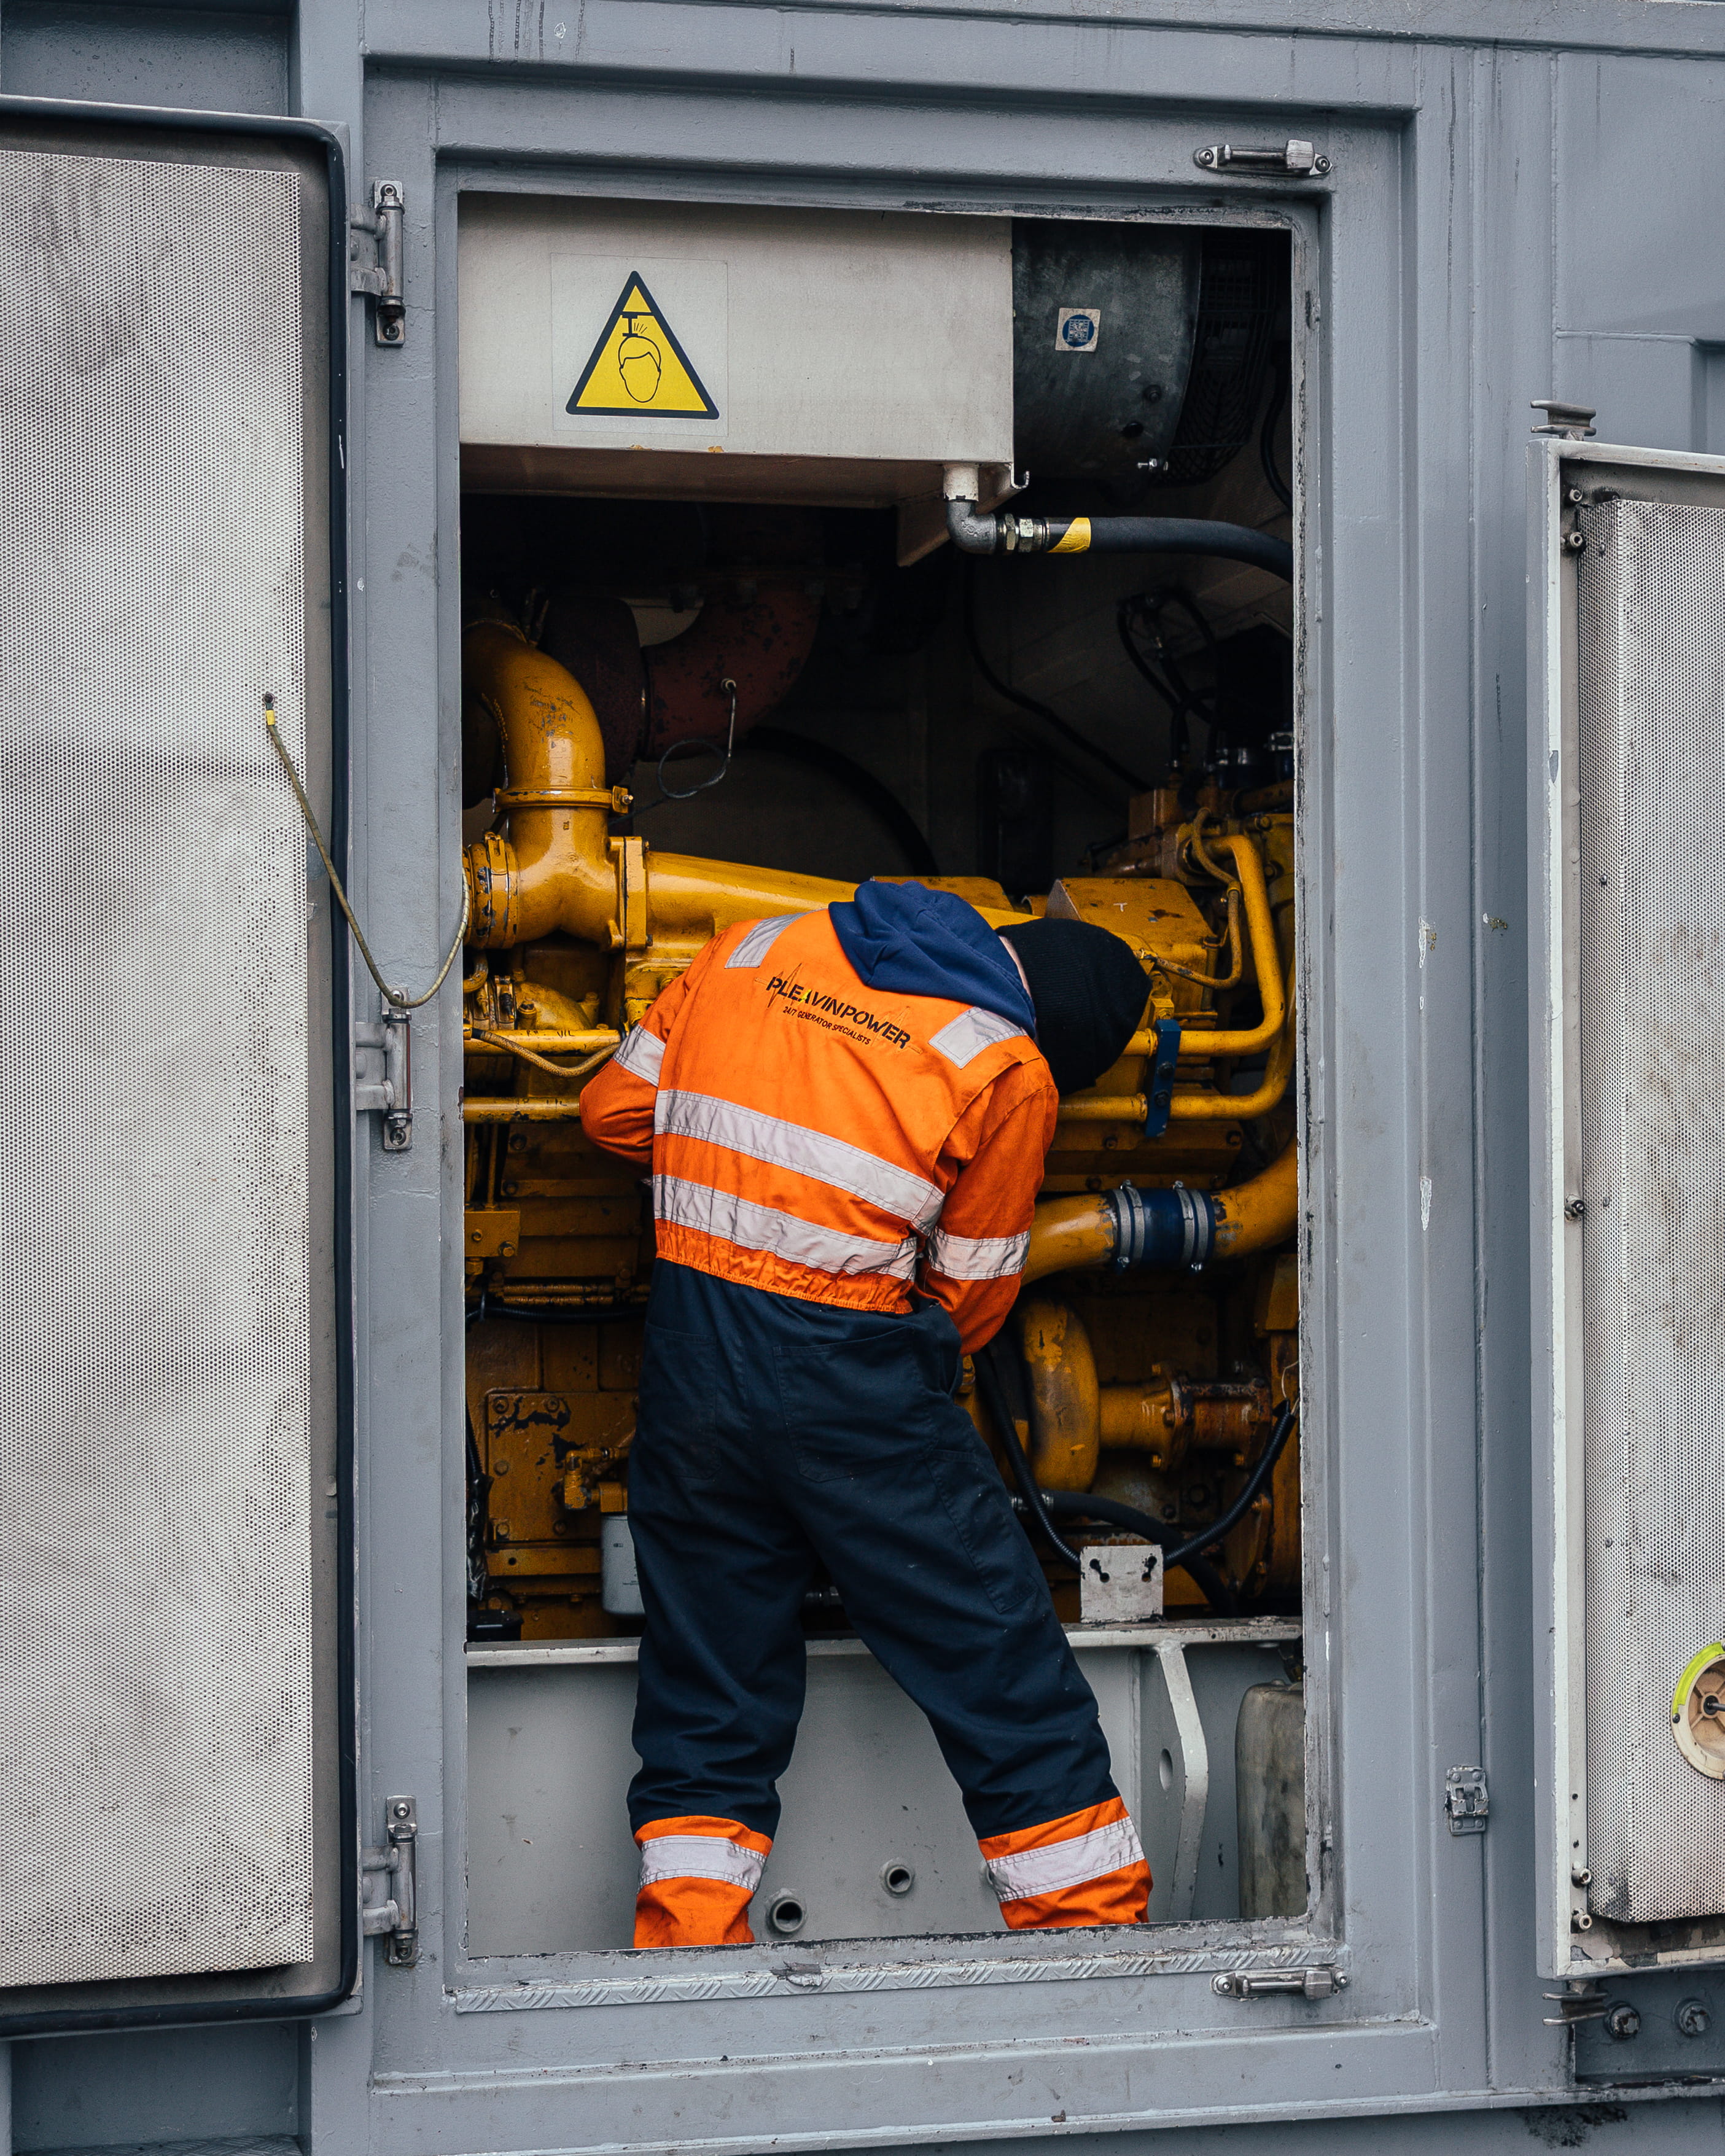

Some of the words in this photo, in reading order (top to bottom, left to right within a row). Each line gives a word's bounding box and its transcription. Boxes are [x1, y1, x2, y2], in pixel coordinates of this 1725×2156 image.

[784, 1006, 796, 1014] 24/7
[798, 1011, 831, 1029] GENERATOR
[832, 1024, 871, 1045] SPECIALISTS
